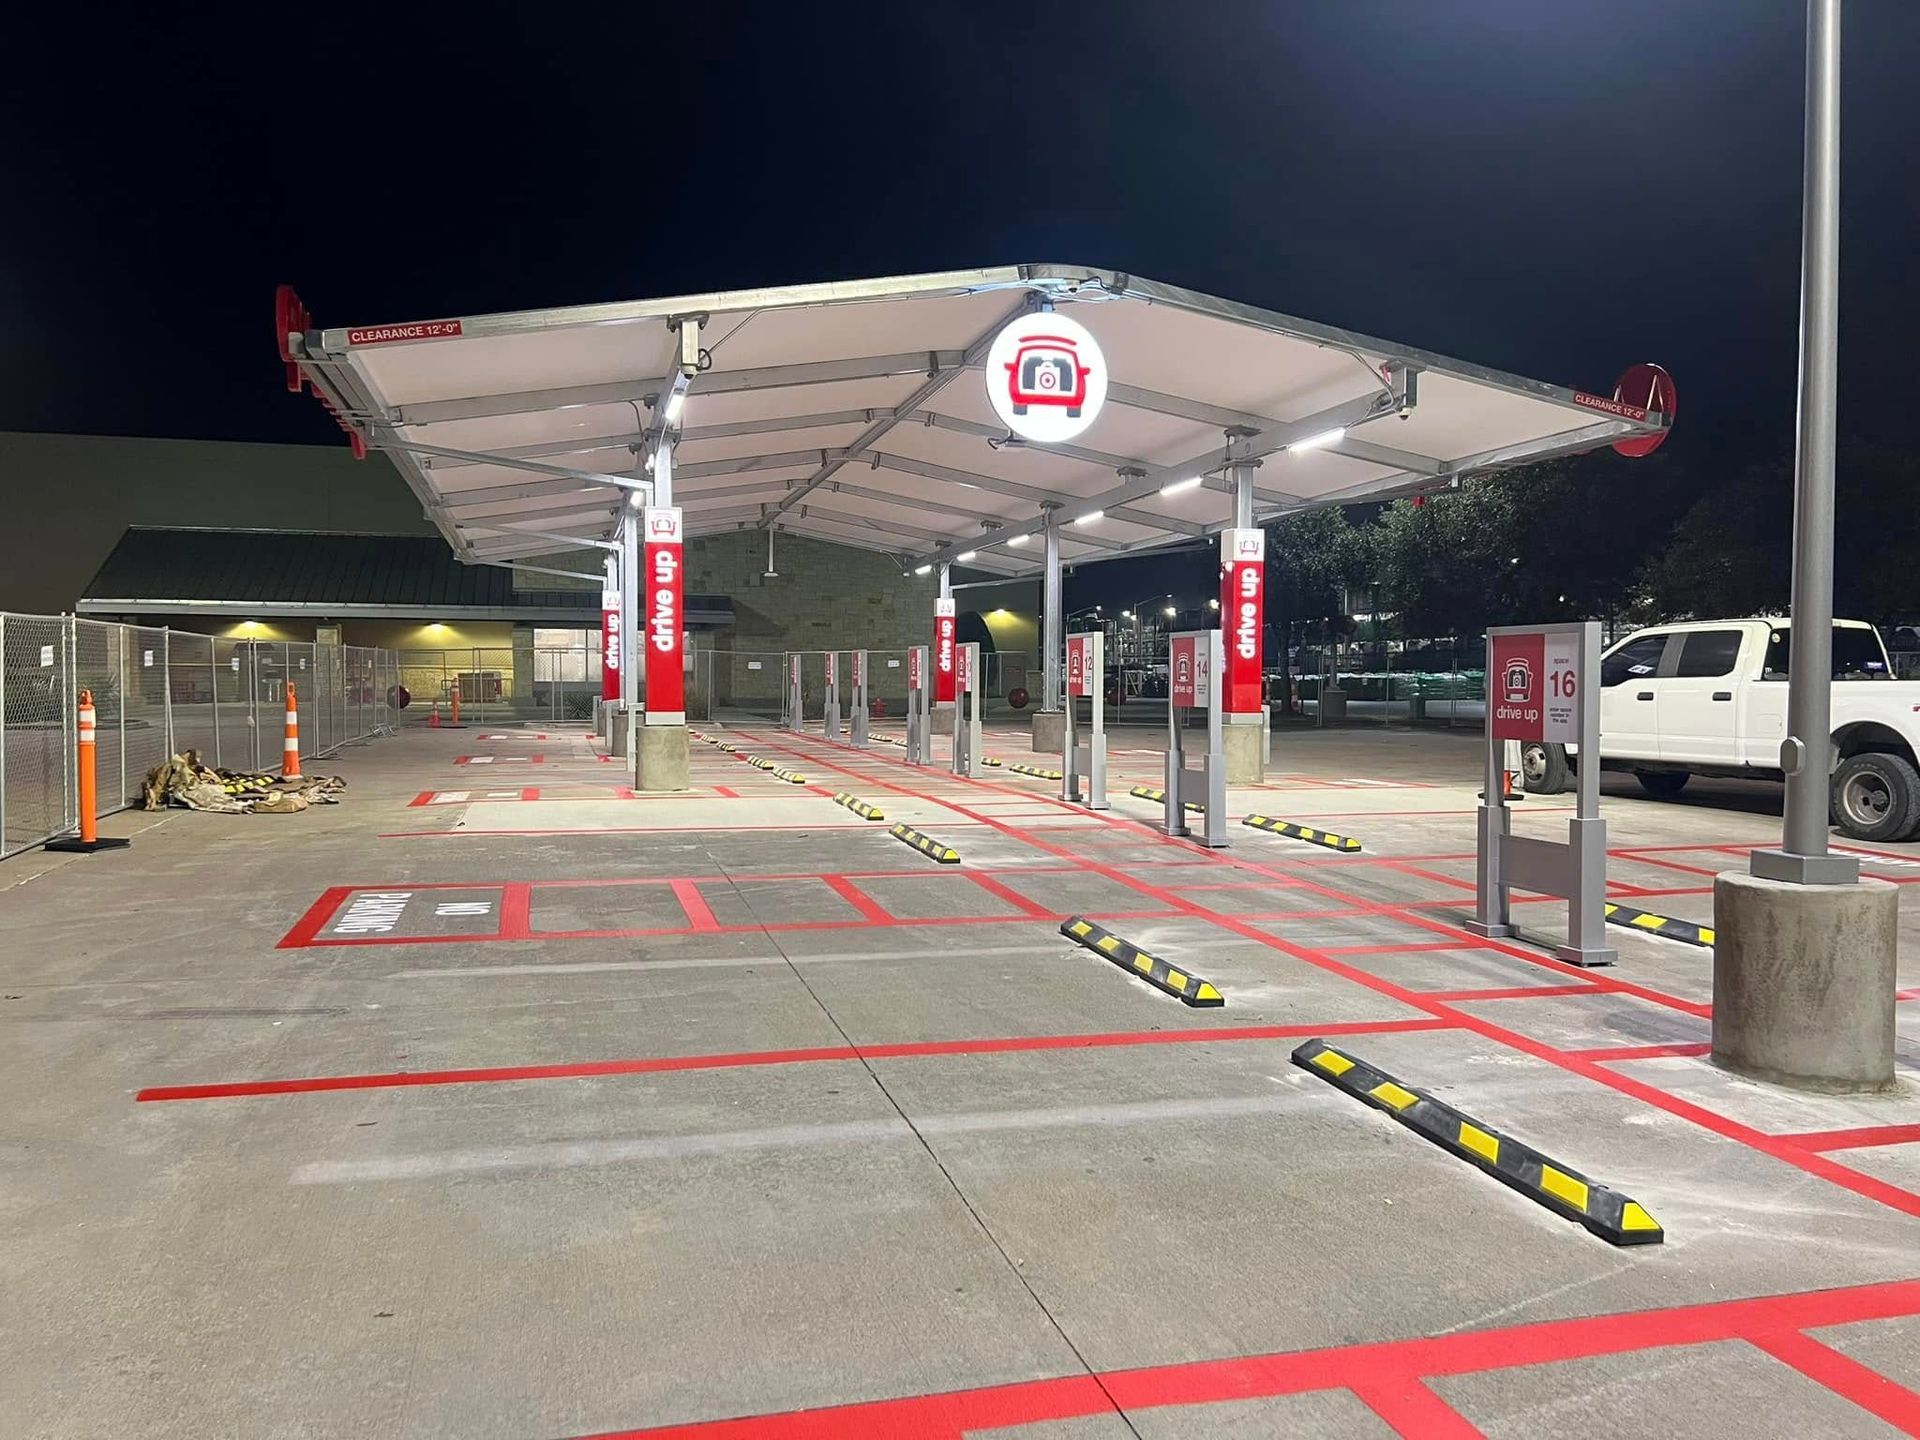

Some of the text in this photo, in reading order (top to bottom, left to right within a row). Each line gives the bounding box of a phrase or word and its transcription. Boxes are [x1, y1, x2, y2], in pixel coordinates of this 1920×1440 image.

[351, 323, 459, 342] CLEARANCE 12'-0"
[1575, 394, 1622, 414] CLEARANCE
[650, 550, 678, 652] drive up
[1236, 567, 1260, 659] drive up
[605, 613, 620, 669] drive up
[939, 620, 953, 672] drive up
[1196, 660, 1208, 678] 14
[1549, 670, 1576, 698] 16
[1496, 705, 1522, 719] drive
[1524, 709, 1538, 723] up
[333, 892, 413, 933] PARKING
[434, 901, 492, 916] NO
